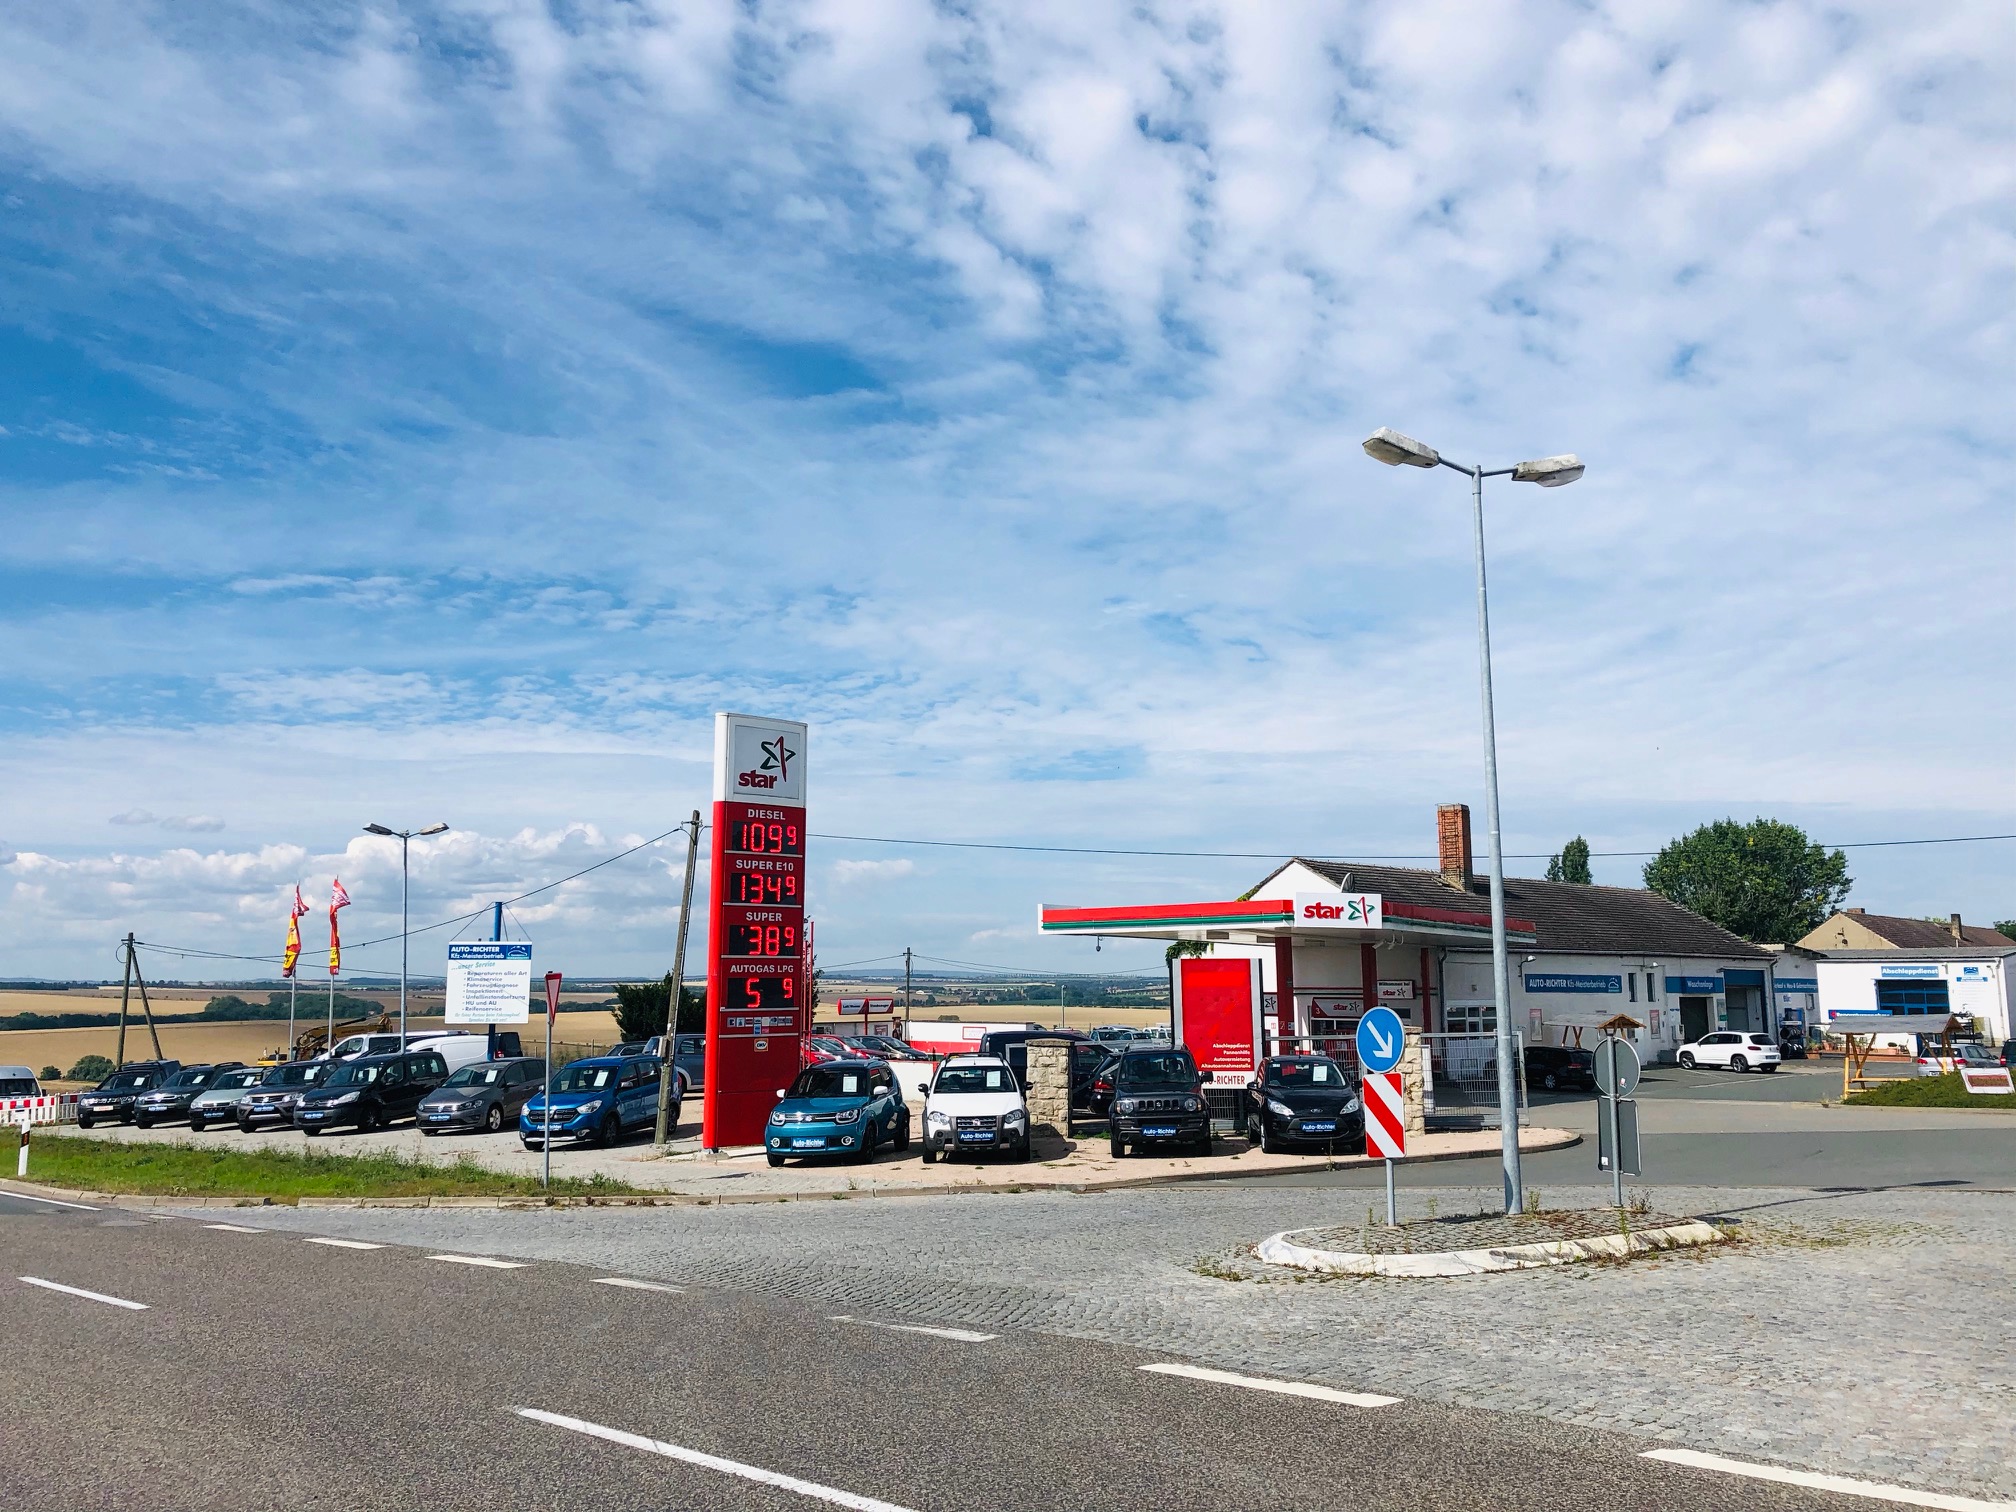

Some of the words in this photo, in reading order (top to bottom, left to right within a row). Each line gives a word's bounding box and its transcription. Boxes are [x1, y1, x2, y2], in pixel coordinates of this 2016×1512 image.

[738, 769, 777, 789] star
[747, 808, 786, 820] DIESEL
[736, 859, 773, 871] SUPER
[776, 861, 794, 871] E10
[1303, 902, 1344, 919] star
[746, 911, 782, 921] SUPER
[730, 964, 775, 973] AUTOGAS
[777, 965, 794, 973] LPG
[1882, 968, 1938, 976] Abschleppdienst
[1529, 979, 1566, 988] AUTO-RICHTER
[1686, 980, 1714, 990] Waschanlage
[1315, 1007, 1320, 1015] 3
[1333, 1003, 1348, 1011] star
[792, 1139, 825, 1147] Auto-Richter
